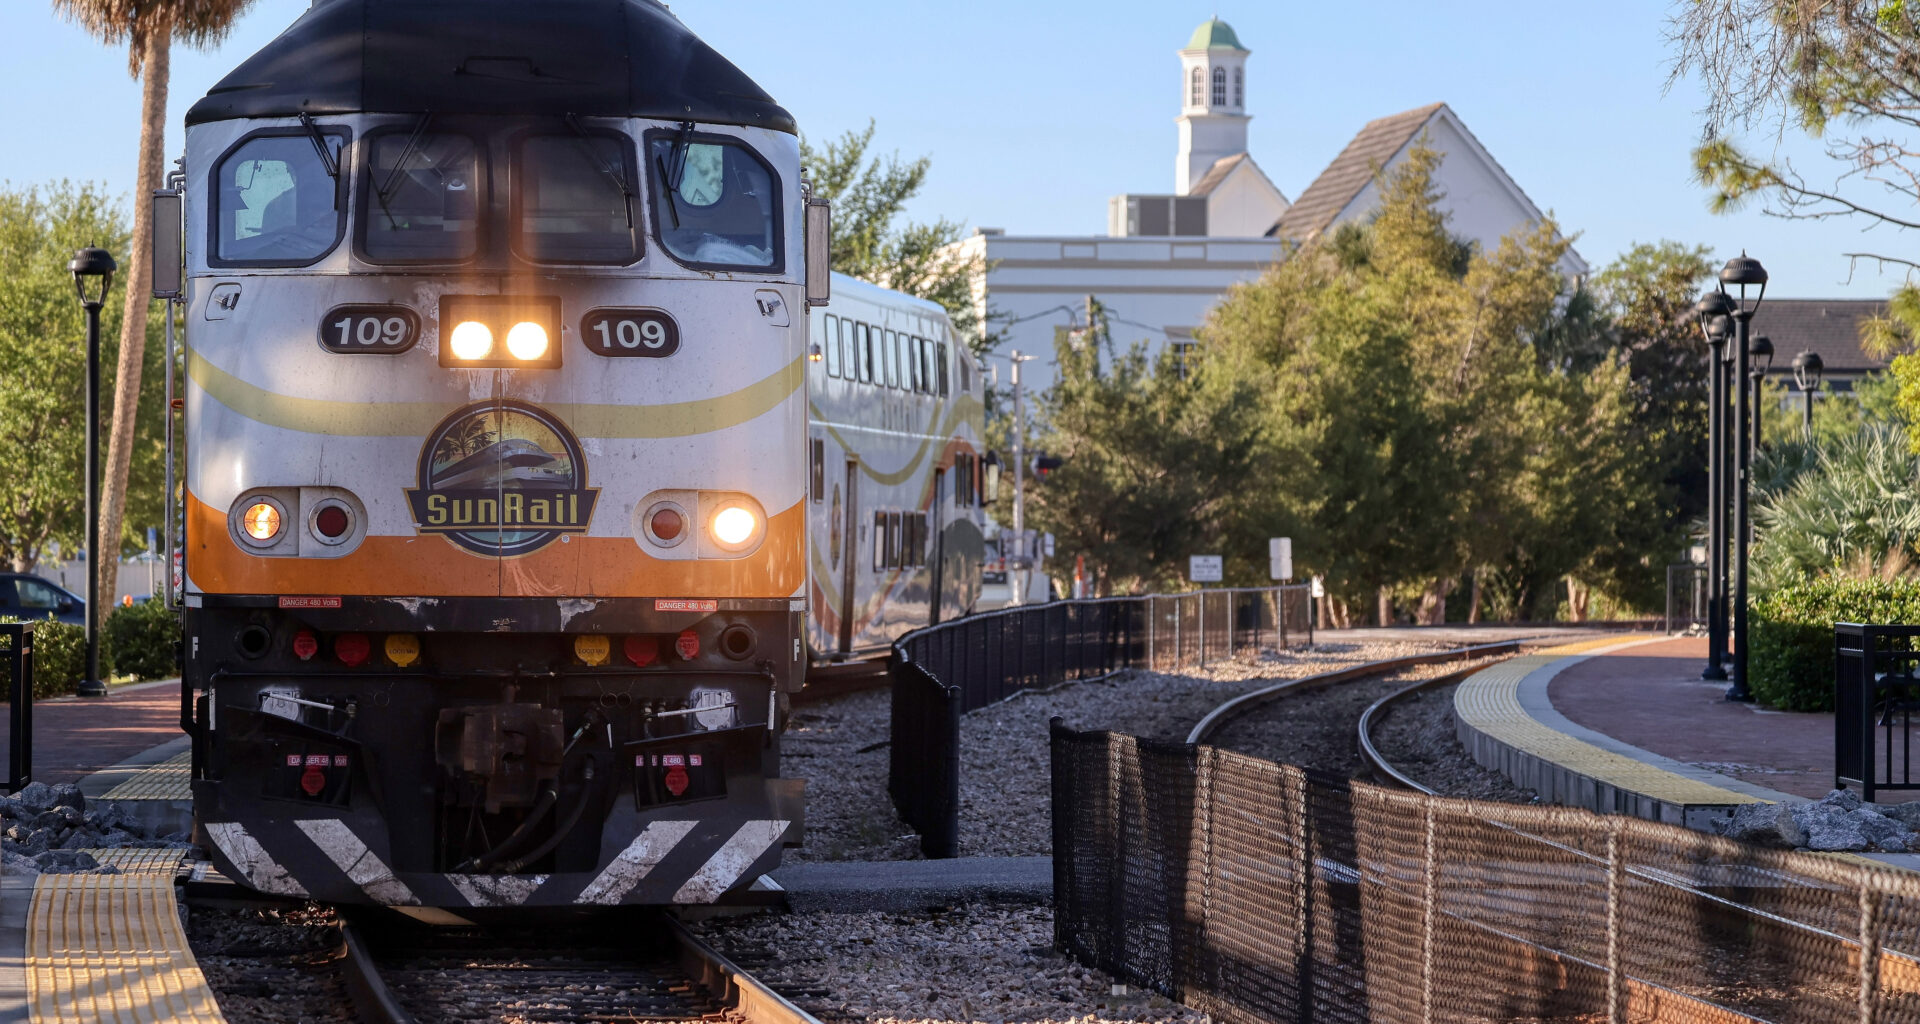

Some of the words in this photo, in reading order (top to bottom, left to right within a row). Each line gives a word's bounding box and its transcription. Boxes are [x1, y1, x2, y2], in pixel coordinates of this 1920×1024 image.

[334, 317, 407, 345] 109
[593, 320, 666, 349] 109
[427, 493, 578, 524] SunRail
[192, 636, 199, 660] F
[793, 638, 800, 662] F
